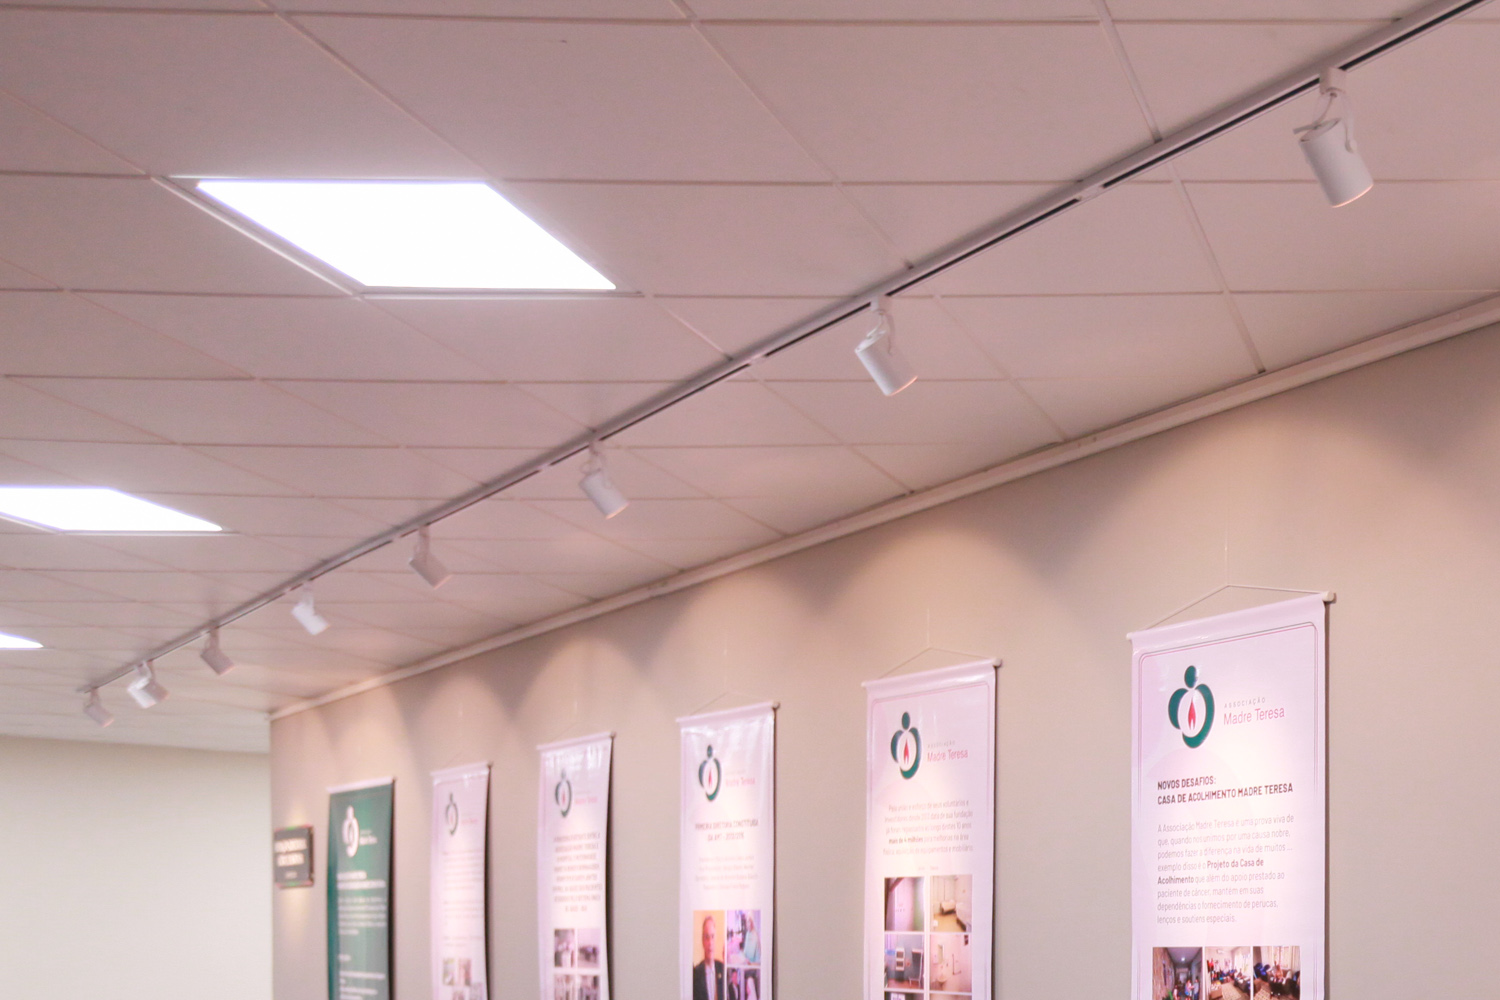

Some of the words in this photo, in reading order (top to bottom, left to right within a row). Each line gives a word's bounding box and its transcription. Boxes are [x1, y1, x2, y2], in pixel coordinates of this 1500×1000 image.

[1224, 712, 1252, 724] Madre
[1255, 708, 1284, 720] Teresa
[948, 749, 968, 759] Teresa
[1158, 779, 1180, 790] NOVOS
[1158, 795, 1176, 805] CASA
[1177, 792, 1187, 803] DE
[1188, 789, 1237, 803] ACOLHIMENTO
[1238, 786, 1262, 796] MADRE
[1264, 783, 1293, 794] TERESA
